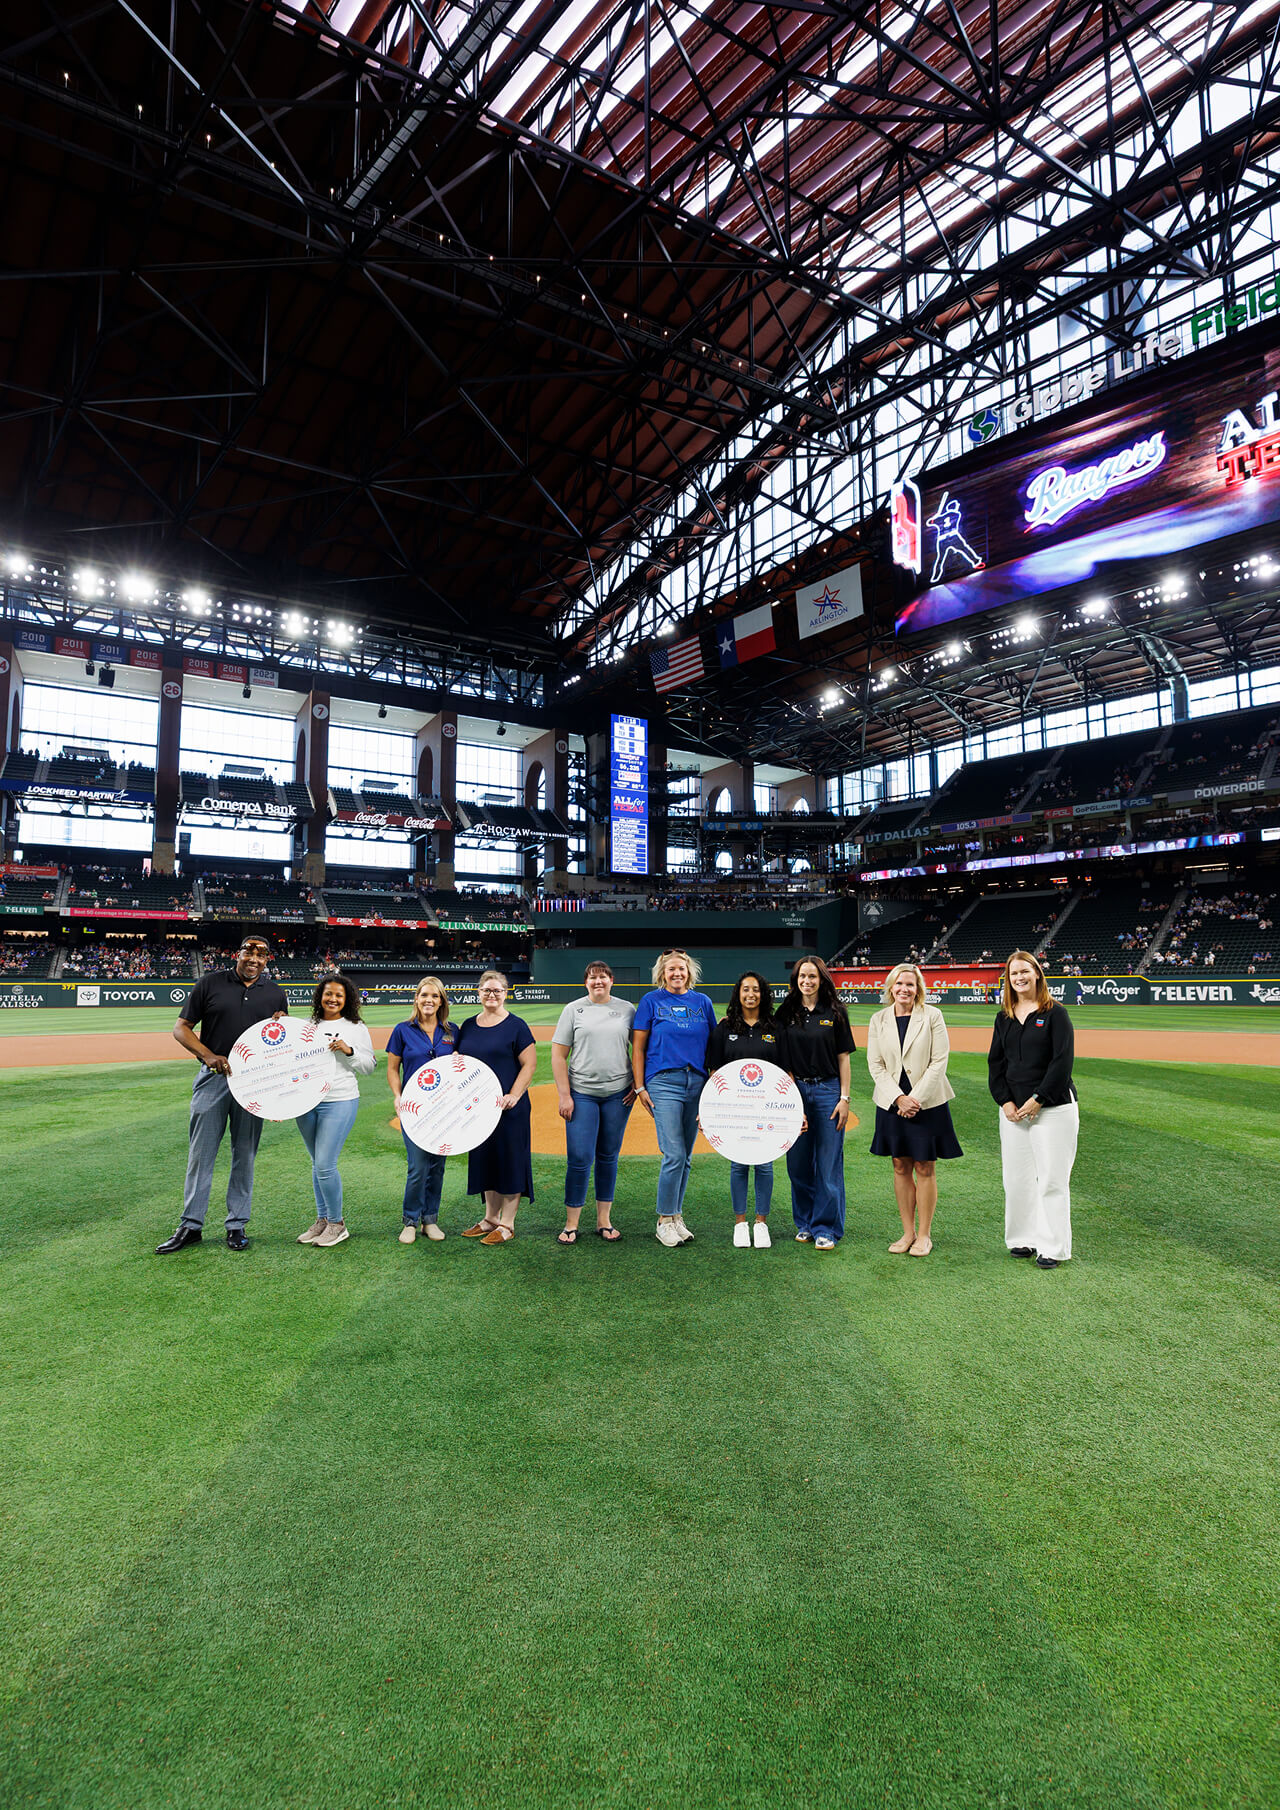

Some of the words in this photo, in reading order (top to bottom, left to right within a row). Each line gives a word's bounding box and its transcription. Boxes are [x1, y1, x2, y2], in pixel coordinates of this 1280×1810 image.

[1009, 369, 1106, 424] Globe
[1113, 332, 1182, 379] Life
[1190, 275, 1280, 345] Field
[1216, 391, 1280, 454] AL
[1217, 431, 1280, 487] TE
[1023, 430, 1167, 533] Rangers
[810, 606, 848, 627] ARLINGTON
[21, 632, 45, 643] 2010
[62, 638, 84, 649] 2011
[100, 644, 120, 655] 2011
[136, 651, 158, 661] 2012
[188, 660, 209, 669] 2015
[222, 664, 243, 674] 2016
[253, 669, 274, 679] 2023
[164, 684, 180, 695] 26
[317, 706, 324, 716] 7
[27, 786, 77, 796] LOCKHEED
[79, 790, 115, 800] MARTIN
[1194, 780, 1265, 799] POWERADE
[613, 795, 634, 805] ALL
[632, 797, 646, 809] for
[264, 803, 297, 816] Bank
[613, 803, 644, 813] TEXAS
[1075, 803, 1118, 814] GoPGL.com
[355, 812, 388, 825] Coca-Cola
[404, 816, 436, 829] Coca-Cola
[480, 824, 530, 837] CHOCTAW
[956, 821, 976, 830] 105.3
[865, 833, 882, 843] UT
[884, 826, 930, 841] DALLAS
[448, 922, 480, 931] LUXOR
[481, 923, 526, 932] STAFFING
[375, 984, 418, 993] LOCKHE
[1097, 979, 1140, 1002] Kroger
[0, 994, 44, 1002] STRELLA
[103, 991, 156, 1001] TOYOTA
[295, 1046, 325, 1061] $10,000
[764, 1101, 796, 1110] $15,000
